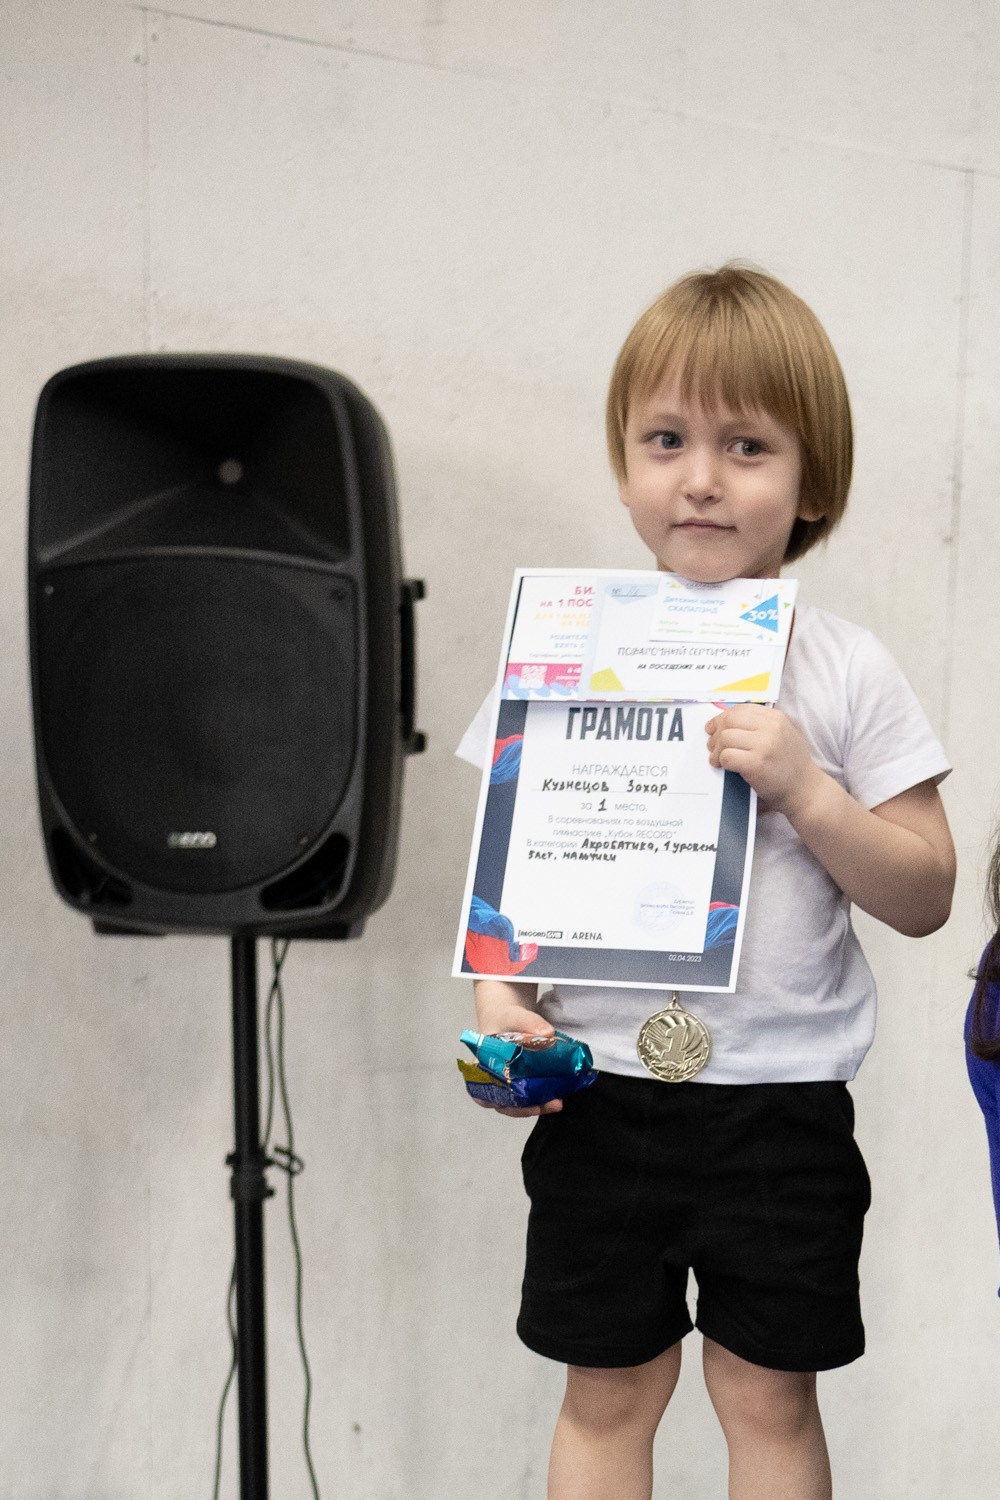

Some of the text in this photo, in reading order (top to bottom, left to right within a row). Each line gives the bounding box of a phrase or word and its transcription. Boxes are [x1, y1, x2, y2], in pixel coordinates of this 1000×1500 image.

[747, 609, 778, 622] 30%
[617, 645, 753, 657] ПОДАРОЧНЫЙ СЕРТИФИКАТ
[566, 707, 685, 741] ГРАМОТА
[571, 763, 668, 777] НАГРАЖДАЕТСЯ
[542, 777, 609, 793] Кузнецов
[580, 803, 592, 811] за
[597, 798, 608, 812] 1
[663, 840, 671, 851] 1
[571, 932, 603, 941] ARENA
[660, 1025, 688, 1063] 1
